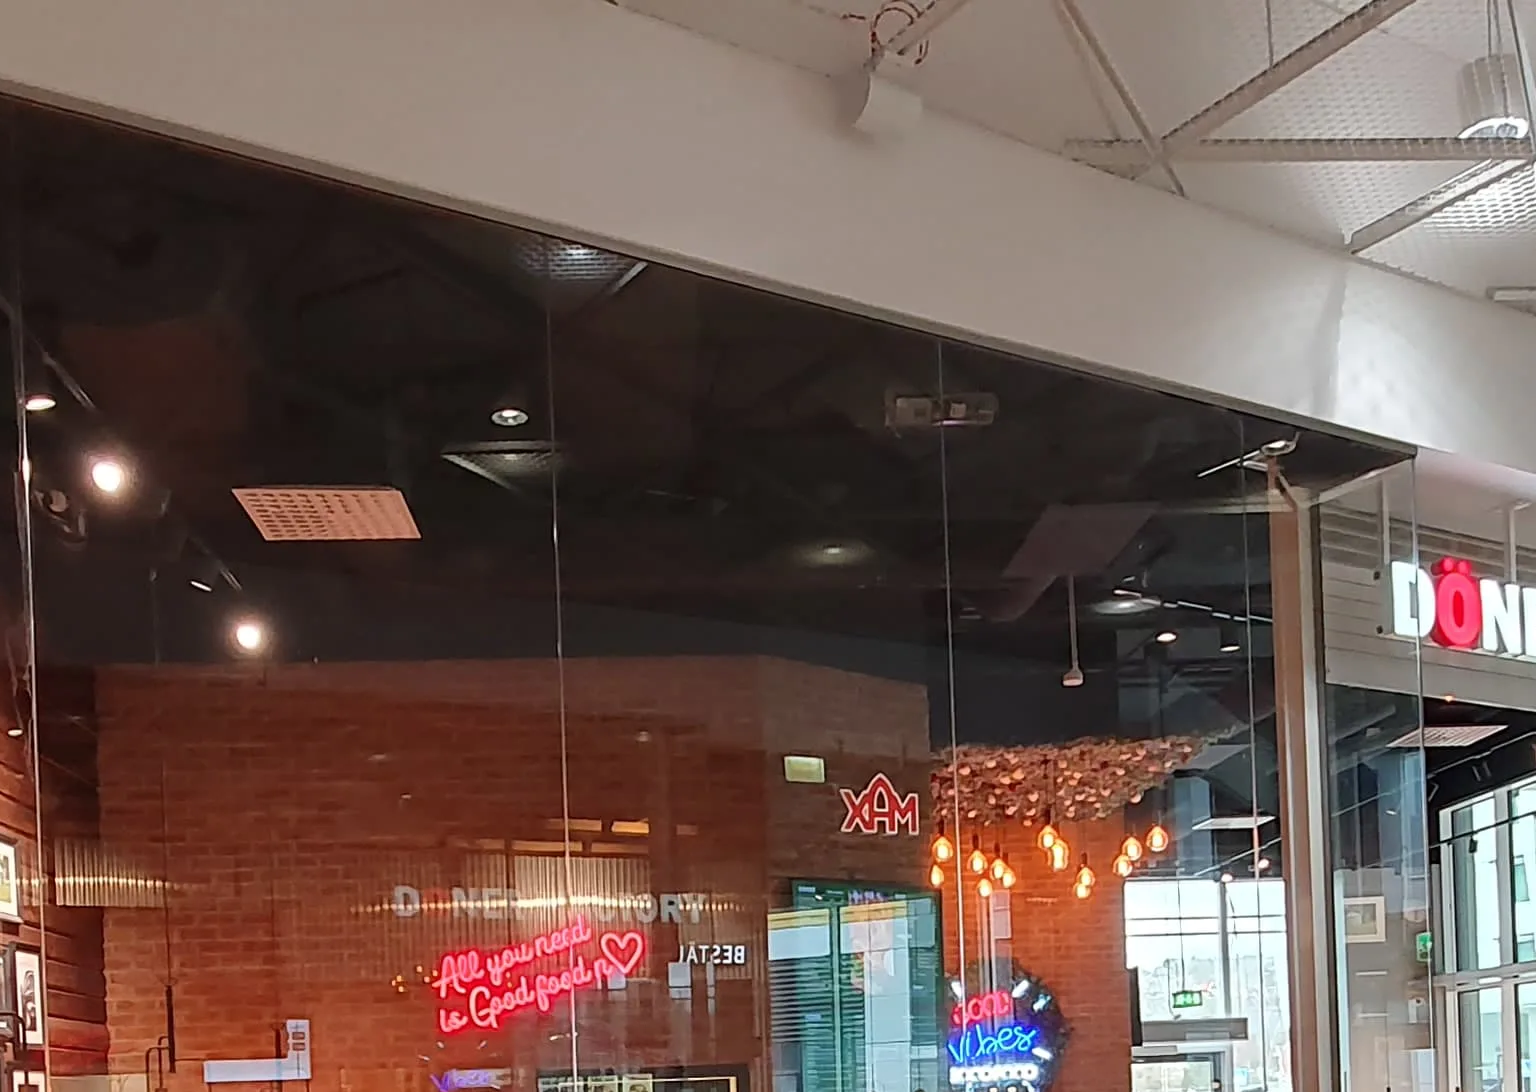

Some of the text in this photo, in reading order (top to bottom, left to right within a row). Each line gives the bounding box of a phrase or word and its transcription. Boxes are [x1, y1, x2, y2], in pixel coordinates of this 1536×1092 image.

[432, 913, 592, 999] All you need
[469, 975, 536, 1029] Good
[535, 956, 593, 1013] food
